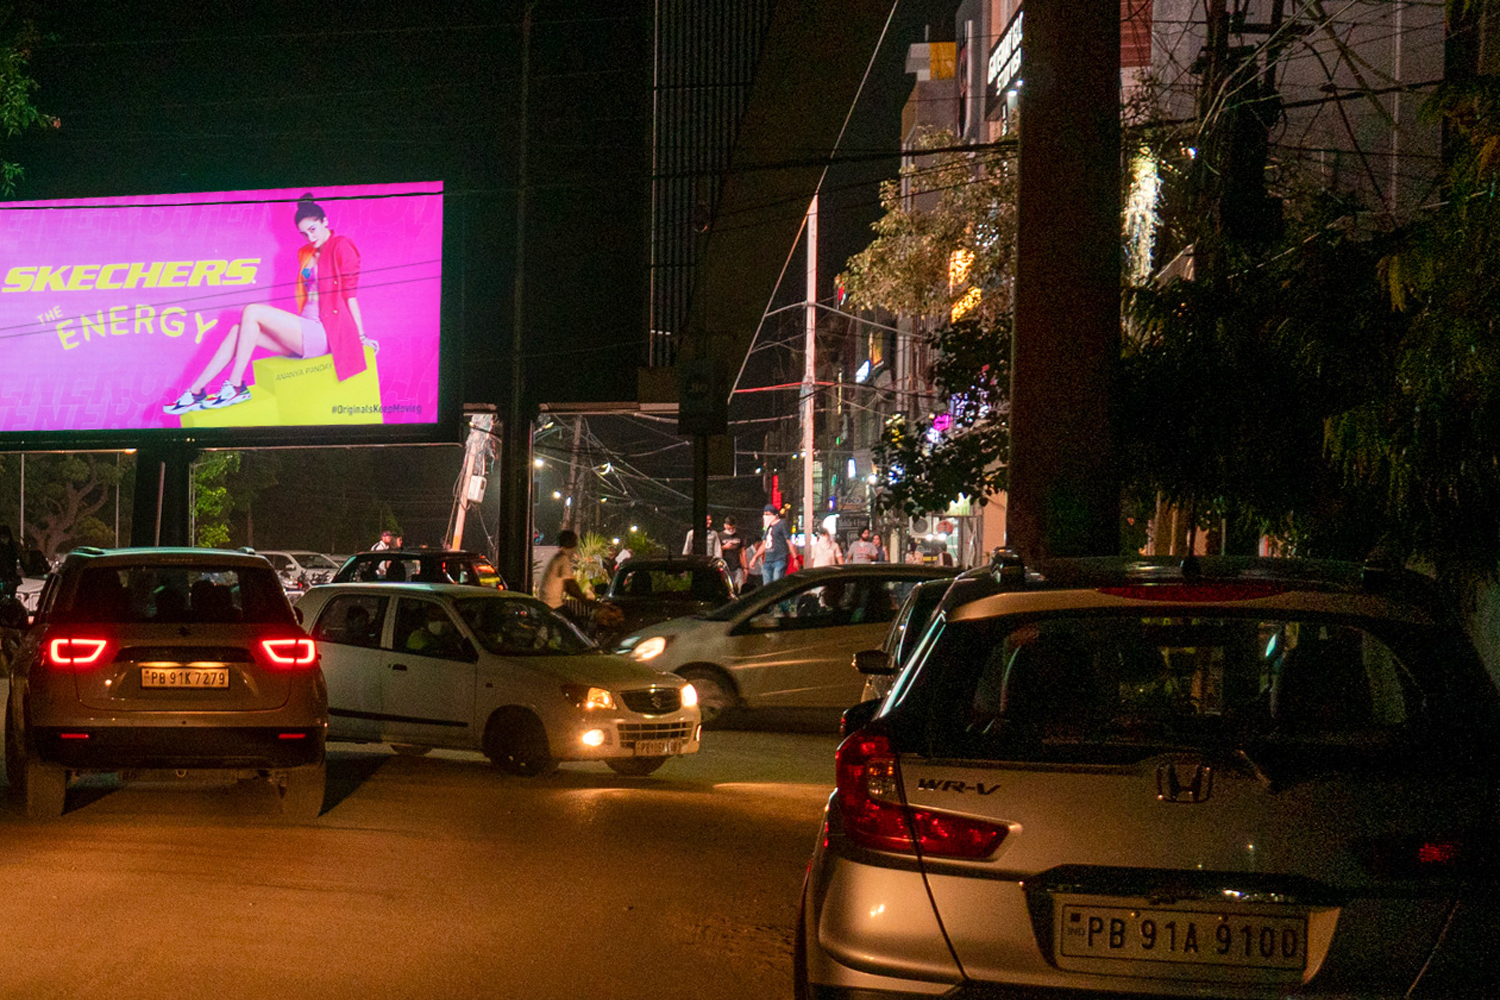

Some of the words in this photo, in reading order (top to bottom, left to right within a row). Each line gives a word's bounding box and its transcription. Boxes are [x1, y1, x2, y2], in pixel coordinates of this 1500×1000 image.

[1, 258, 261, 293] SKECHERS
[36, 305, 64, 326] THE
[55, 304, 218, 350] ENERGY
[151, 672, 166, 684] PB
[170, 672, 191, 684] 91K
[195, 672, 225, 685] 7279
[917, 778, 1001, 796] WR-V
[1088, 916, 1125, 949] PB
[1141, 919, 1198, 953] 91A
[1216, 924, 1297, 958] 9100
